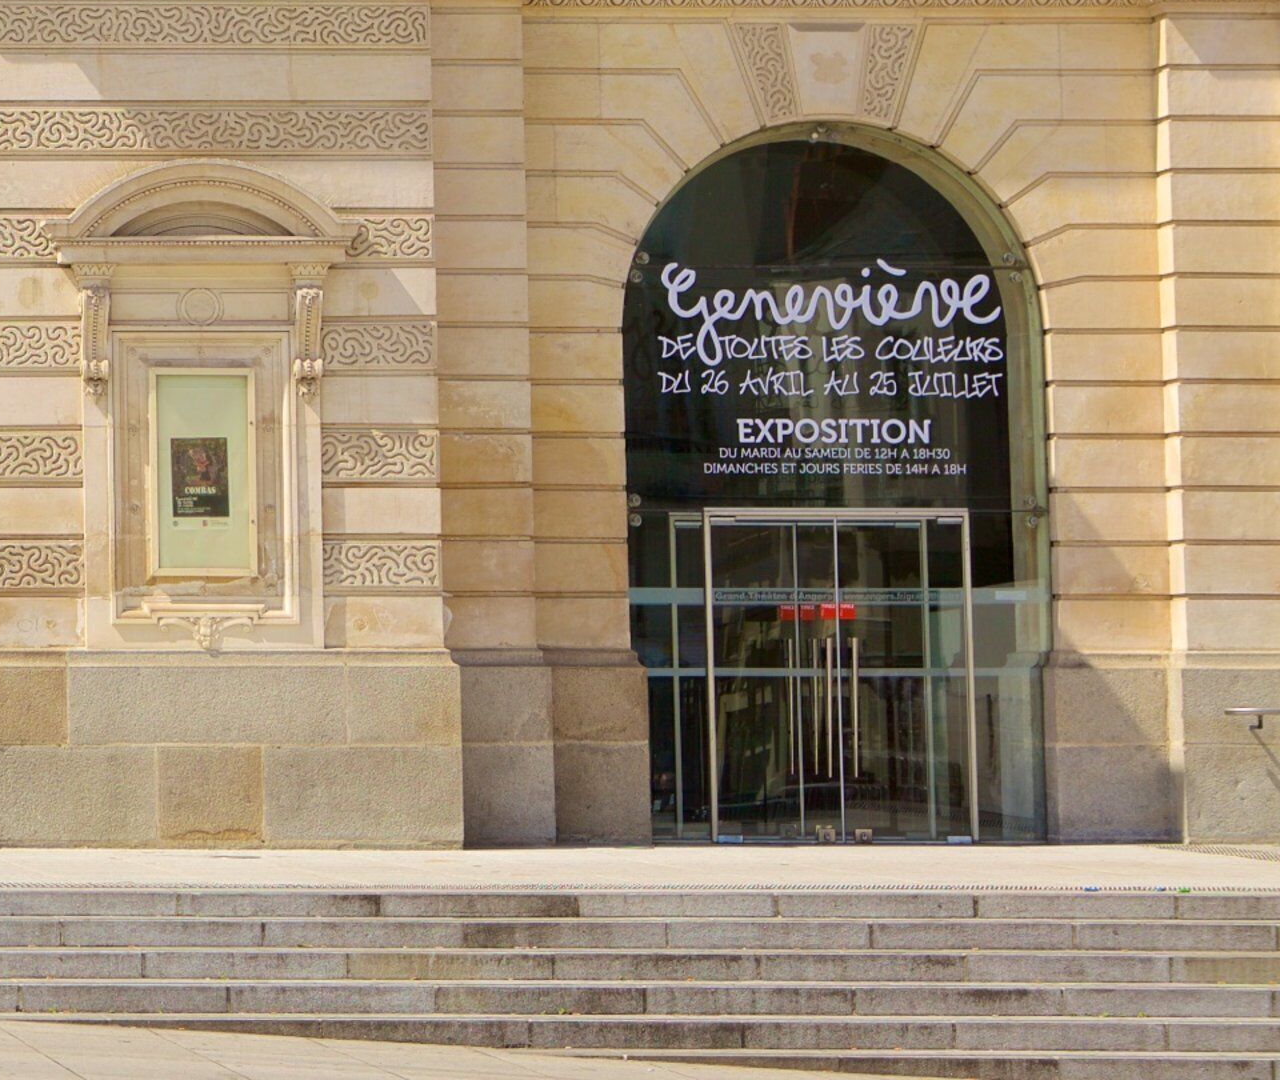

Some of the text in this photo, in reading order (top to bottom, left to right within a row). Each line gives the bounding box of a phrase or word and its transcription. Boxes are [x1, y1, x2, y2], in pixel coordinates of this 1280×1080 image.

[659, 259, 1002, 366] Geneviève
[657, 333, 1004, 363] DE TOUTES LES COULEURS
[657, 367, 1003, 399] DU 26 AVRIL AU 25 JUILLET
[737, 418, 931, 444] EXPOSITION
[719, 448, 951, 459] DU MARDI AU SAMEDI DE 12H A 18H30
[704, 463, 967, 475] DIMANCHES ET JOURS FERIES DE 14H A 18H
